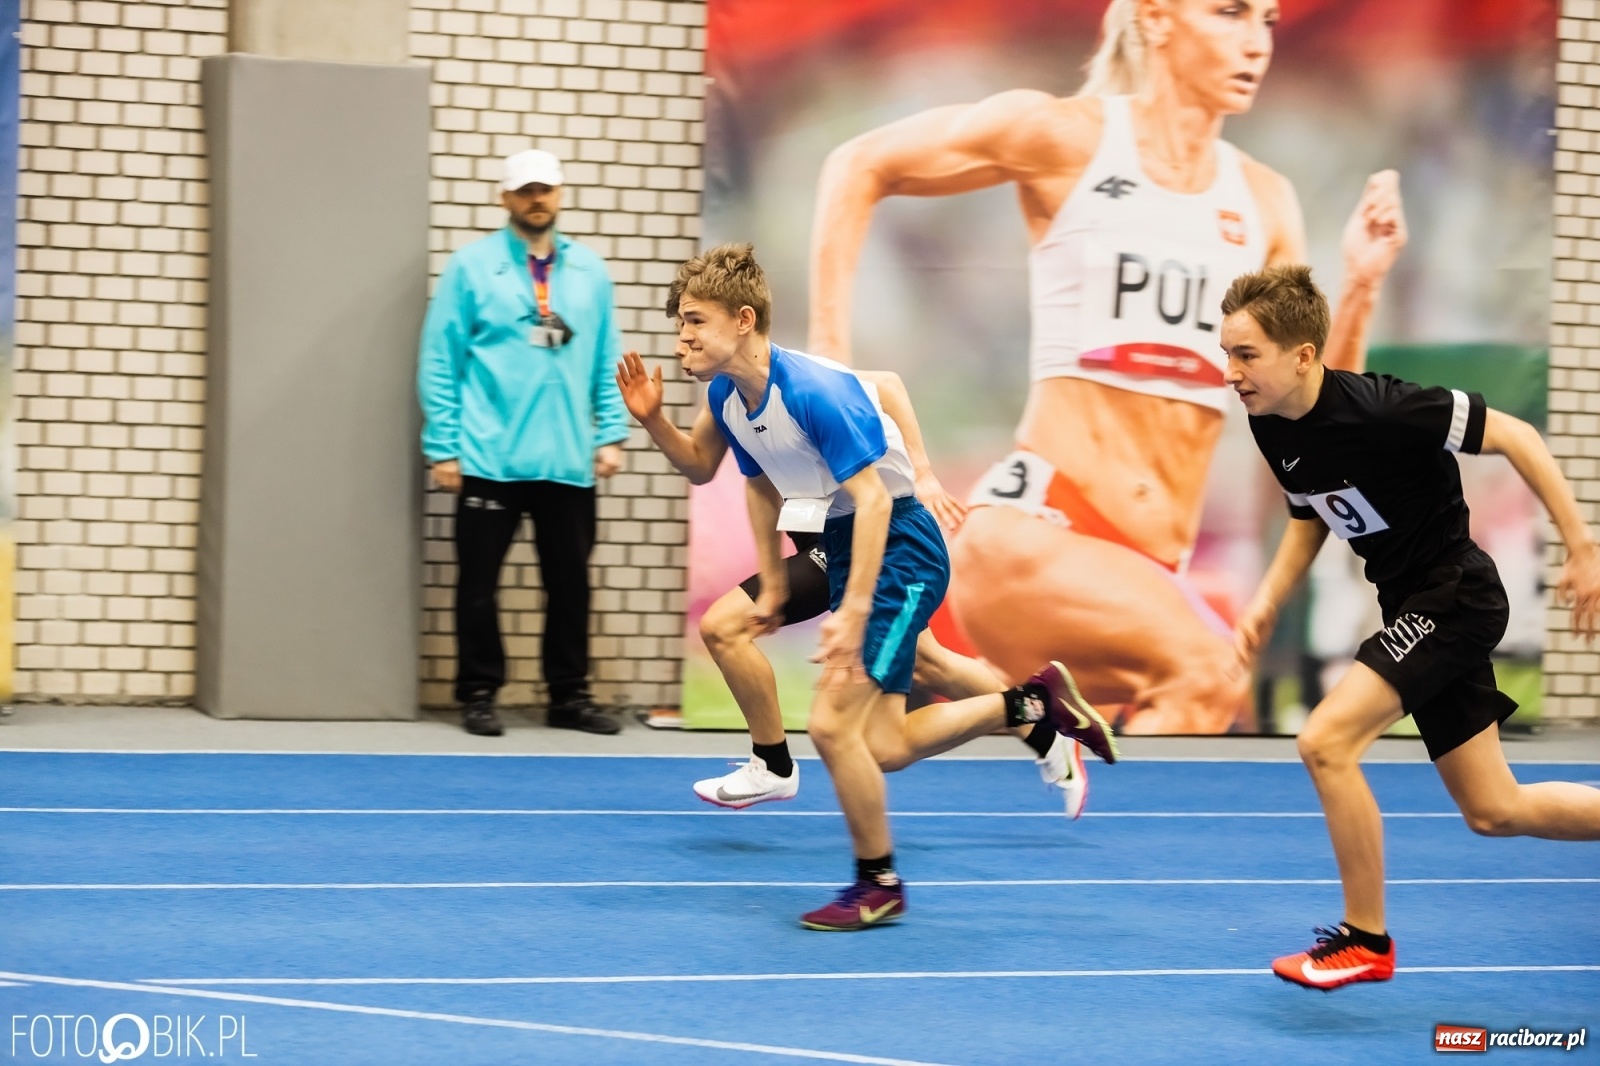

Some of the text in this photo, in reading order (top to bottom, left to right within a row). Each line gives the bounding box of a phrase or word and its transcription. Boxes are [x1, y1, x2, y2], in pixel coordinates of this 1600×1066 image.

[1093, 176, 1138, 199] 4F
[1112, 252, 1215, 332] POL
[990, 460, 1027, 499] 3
[1325, 493, 1367, 534] 9
